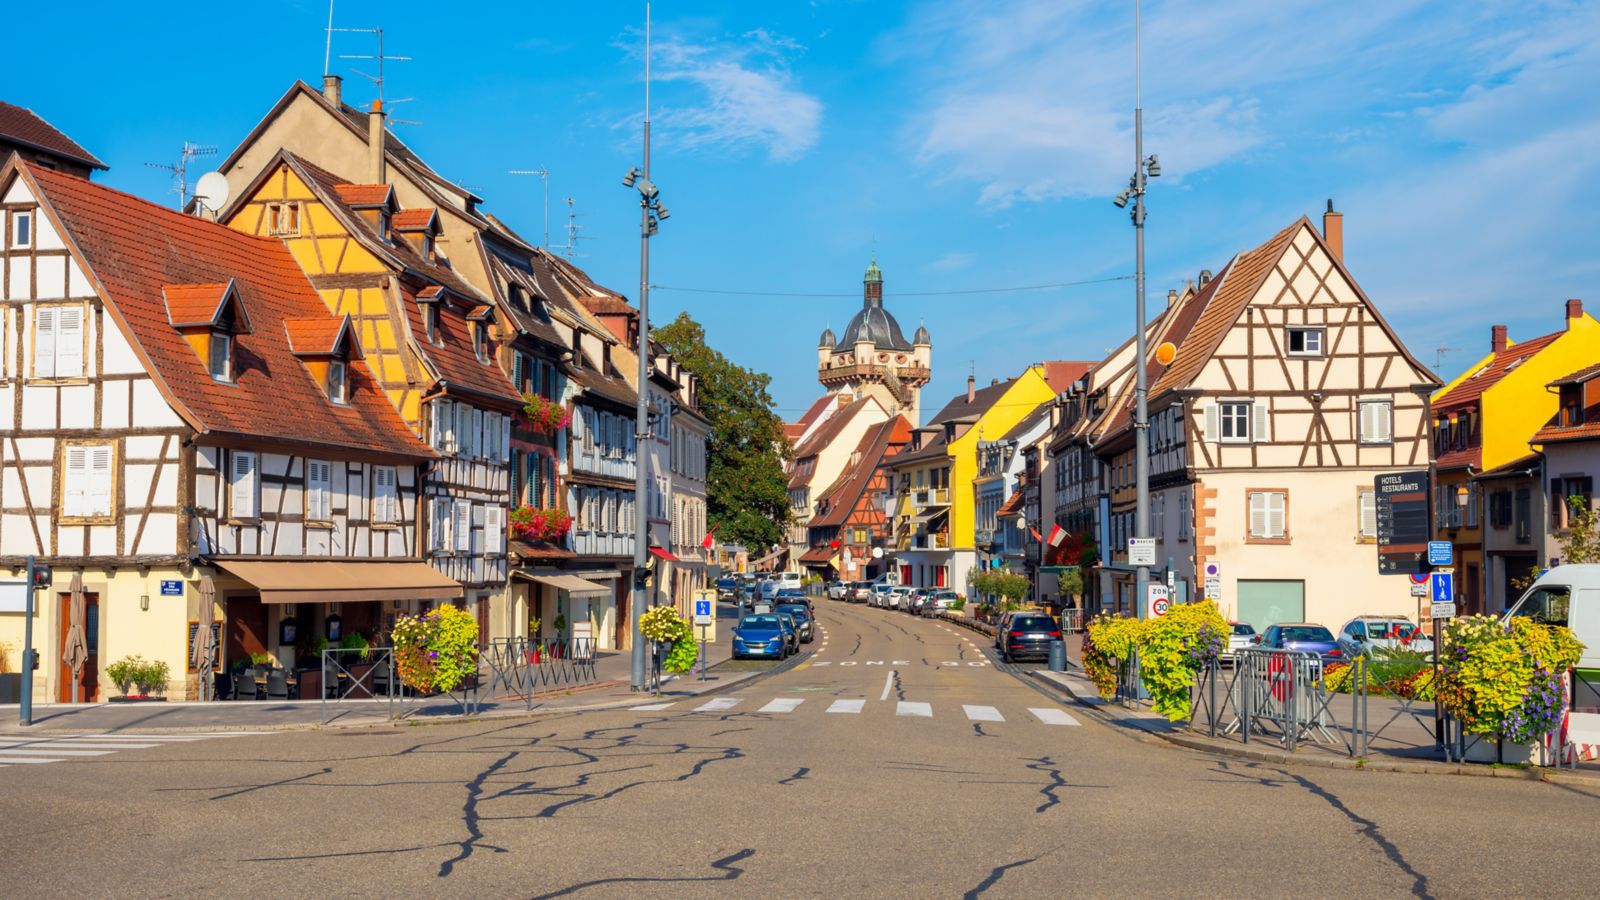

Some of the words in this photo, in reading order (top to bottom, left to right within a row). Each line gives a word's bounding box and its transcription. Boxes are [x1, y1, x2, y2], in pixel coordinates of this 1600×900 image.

[1381, 475, 1402, 484] HOTELS
[1381, 483, 1419, 493] RESTAURANTS
[1157, 603, 1168, 611] 30
